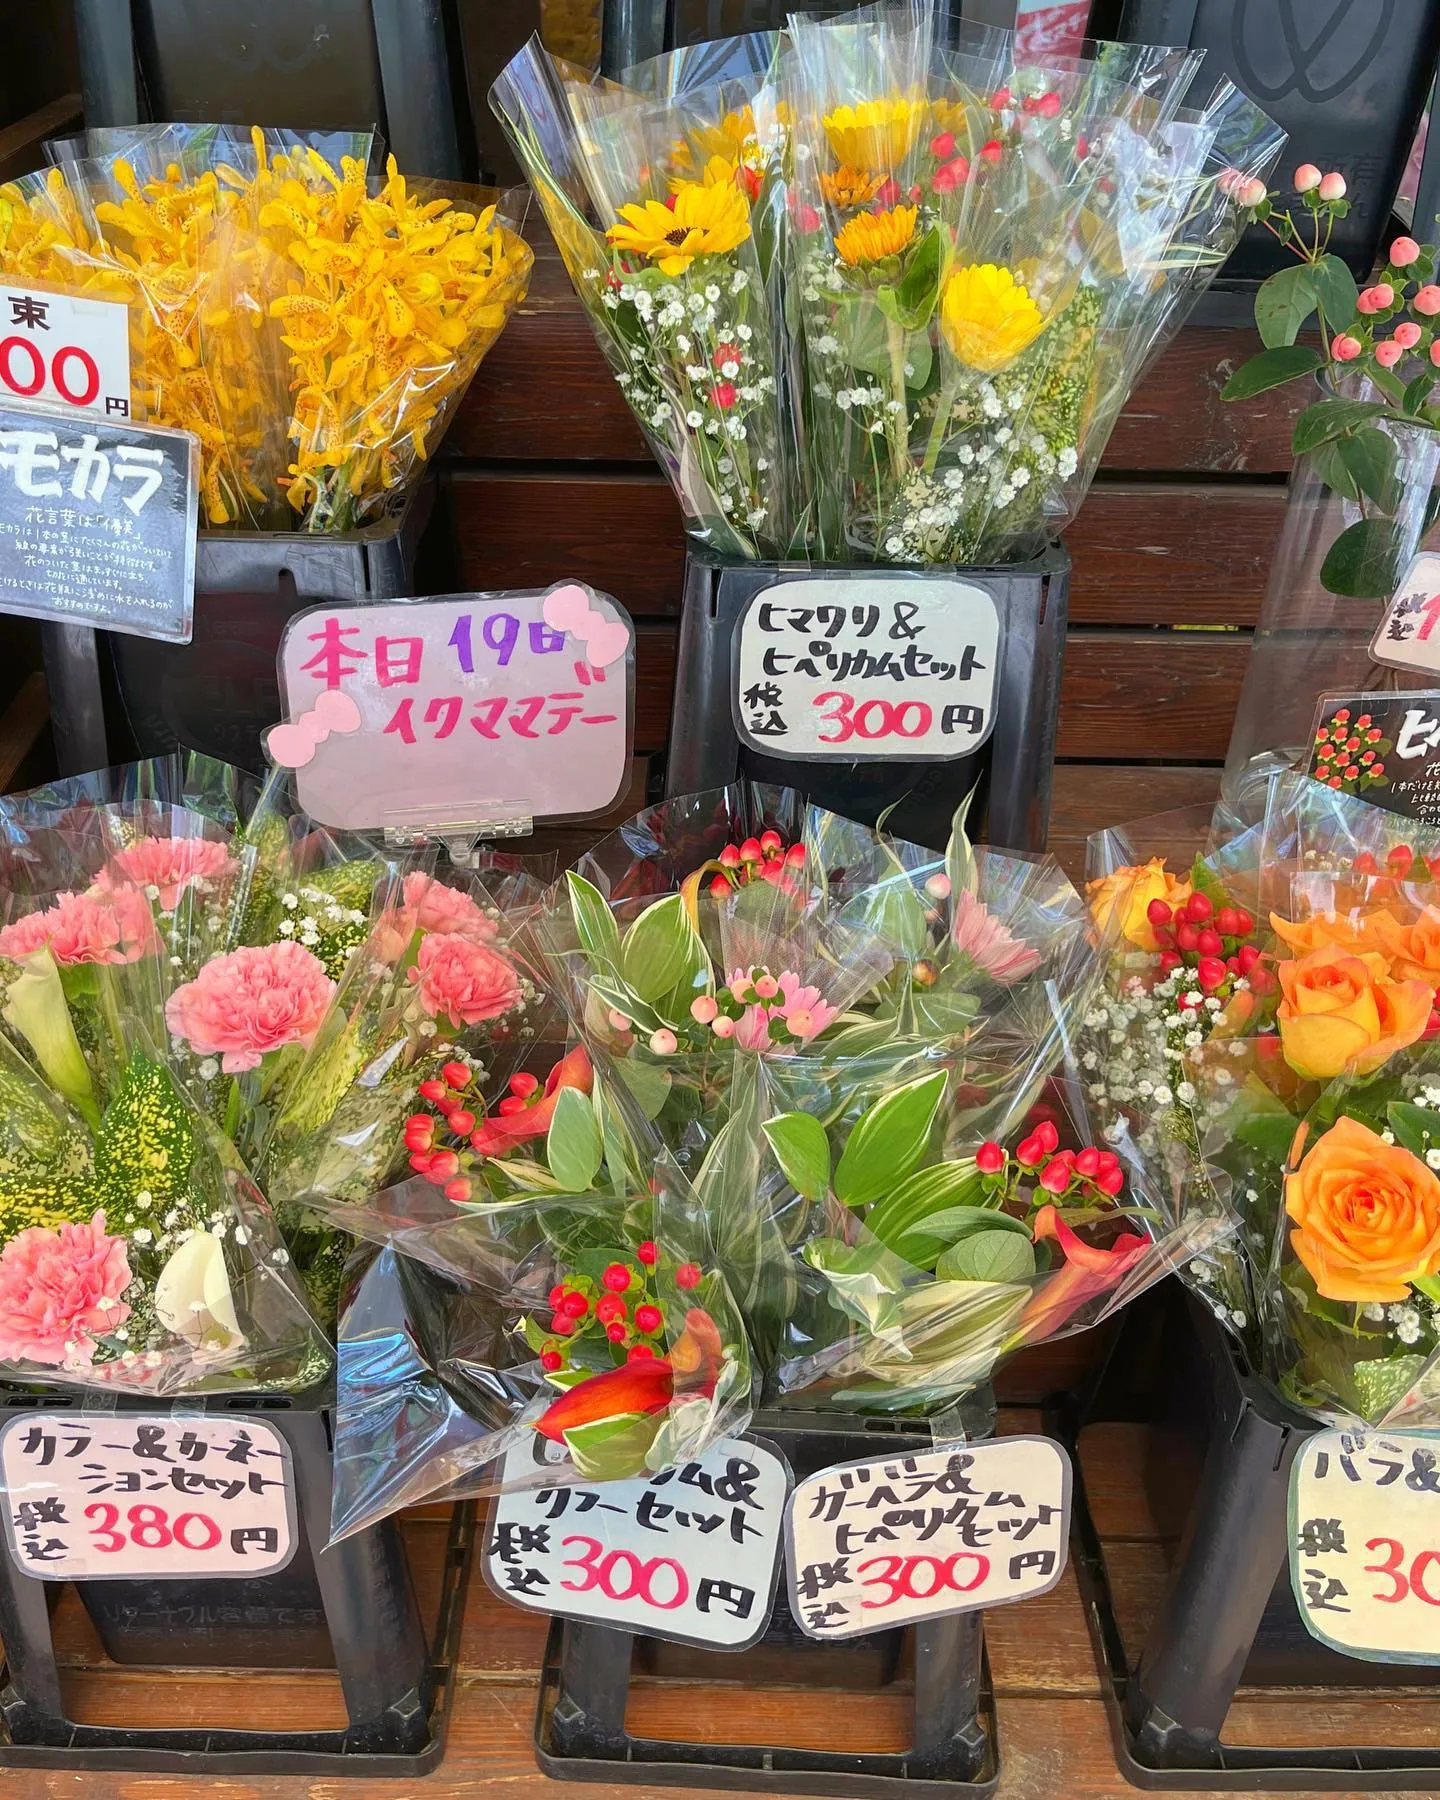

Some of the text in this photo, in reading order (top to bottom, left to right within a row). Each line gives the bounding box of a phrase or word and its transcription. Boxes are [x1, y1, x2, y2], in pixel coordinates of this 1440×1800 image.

[0, 430, 164, 517] モカラ
[300, 617, 424, 691] 本日
[1396, 709, 1440, 760] ヒ
